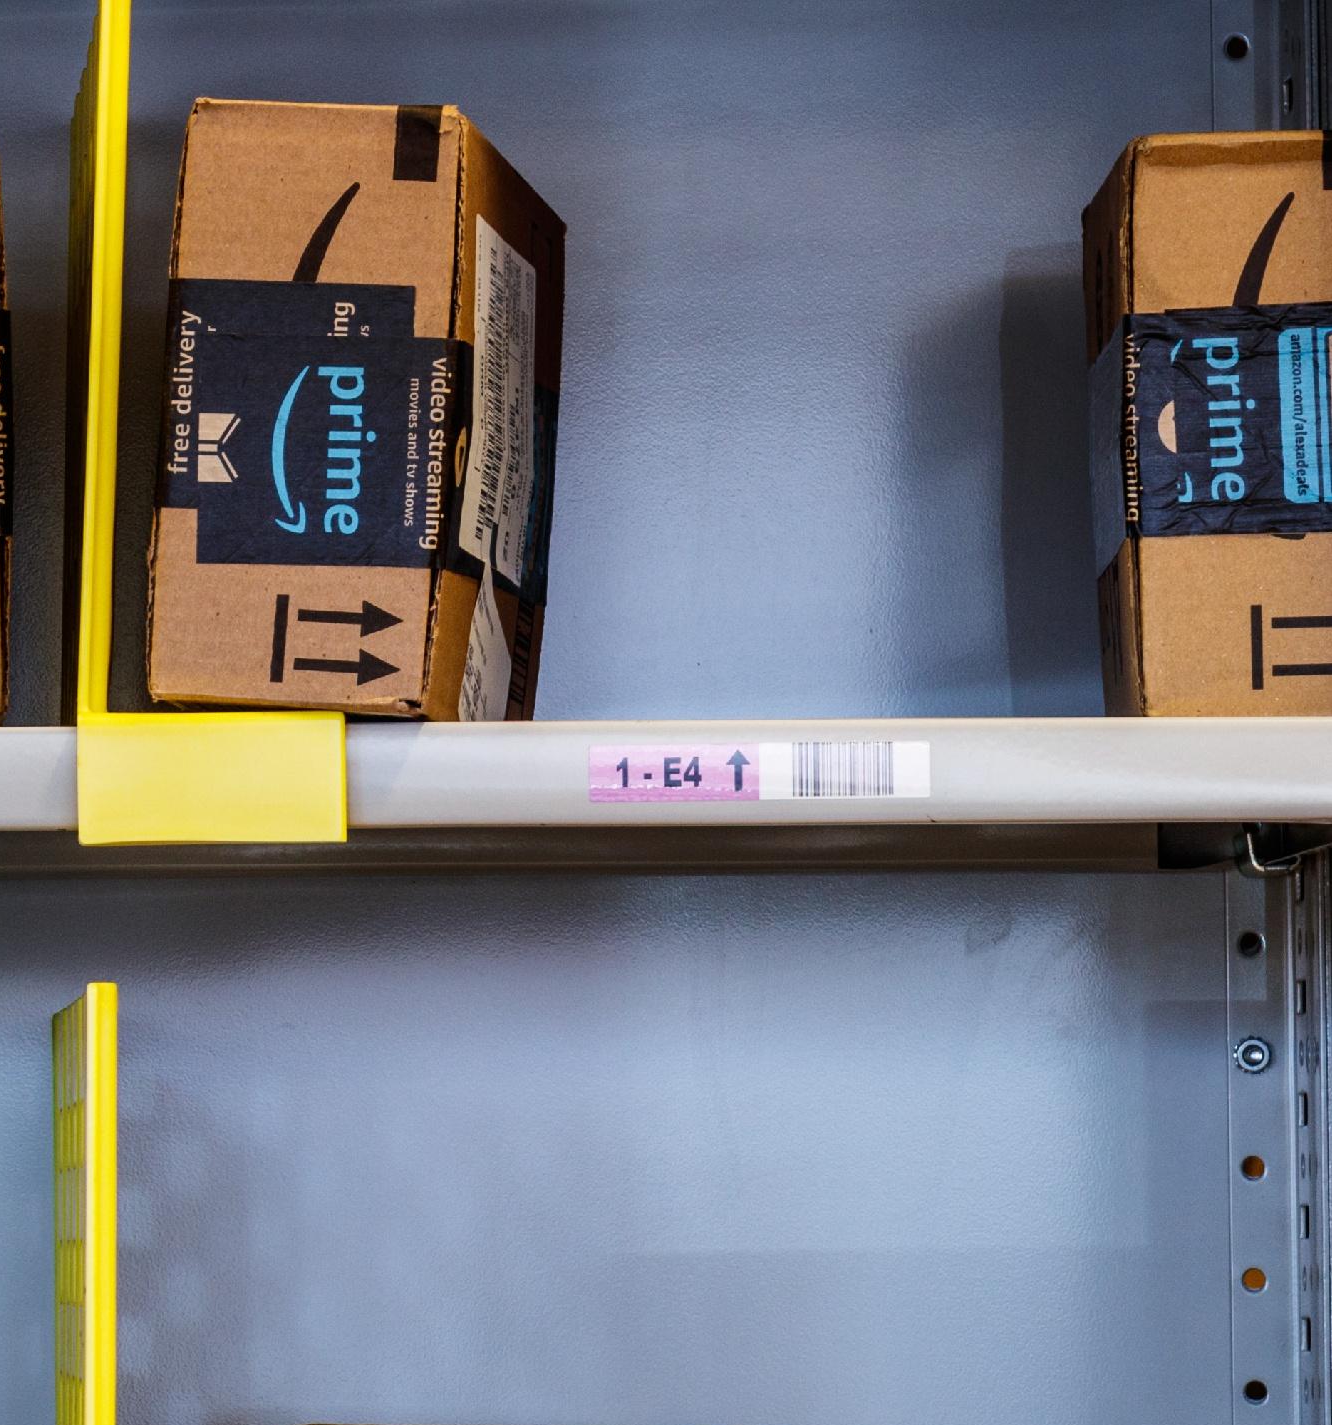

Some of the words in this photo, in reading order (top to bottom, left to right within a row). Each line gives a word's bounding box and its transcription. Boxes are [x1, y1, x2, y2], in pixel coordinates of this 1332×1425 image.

[171, 310, 202, 414] delivery
[429, 357, 452, 422] video
[1124, 334, 1141, 396] video
[407, 378, 421, 428] movies
[1192, 337, 1255, 501] prime
[1290, 333, 1310, 496] amazon.com/alexadeals
[168, 424, 191, 474] free
[318, 366, 376, 535] prime
[406, 461, 418, 479] tv
[407, 433, 419, 458] and
[1125, 404, 1143, 522] streaming
[403, 481, 418, 527] shows
[419, 427, 448, 550] streaming
[616, 757, 628, 788] 1
[664, 757, 702, 788] E4
